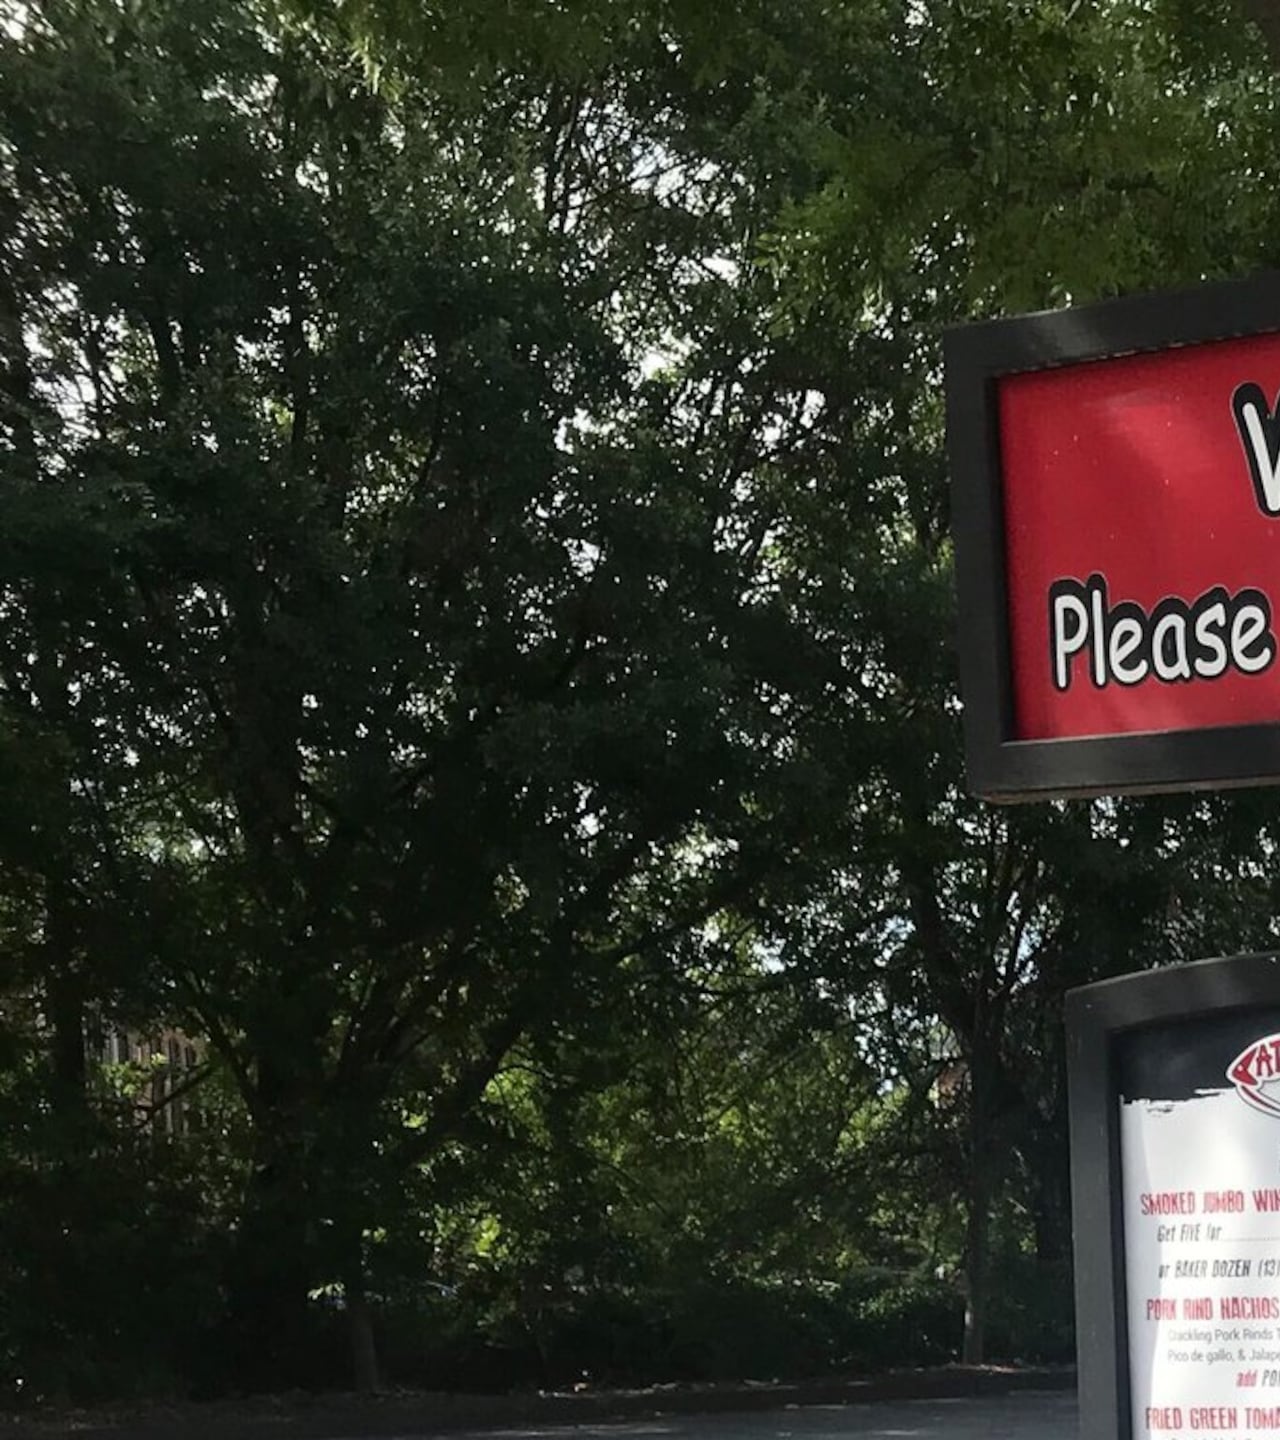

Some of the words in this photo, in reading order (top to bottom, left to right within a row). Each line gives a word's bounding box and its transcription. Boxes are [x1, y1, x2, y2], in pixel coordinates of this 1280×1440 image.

[1049, 586, 1273, 691] Please
[1141, 1192, 1195, 1215] SMOKED
[1146, 1409, 1182, 1430] FRIED
[1190, 1407, 1237, 1430] GREEN
